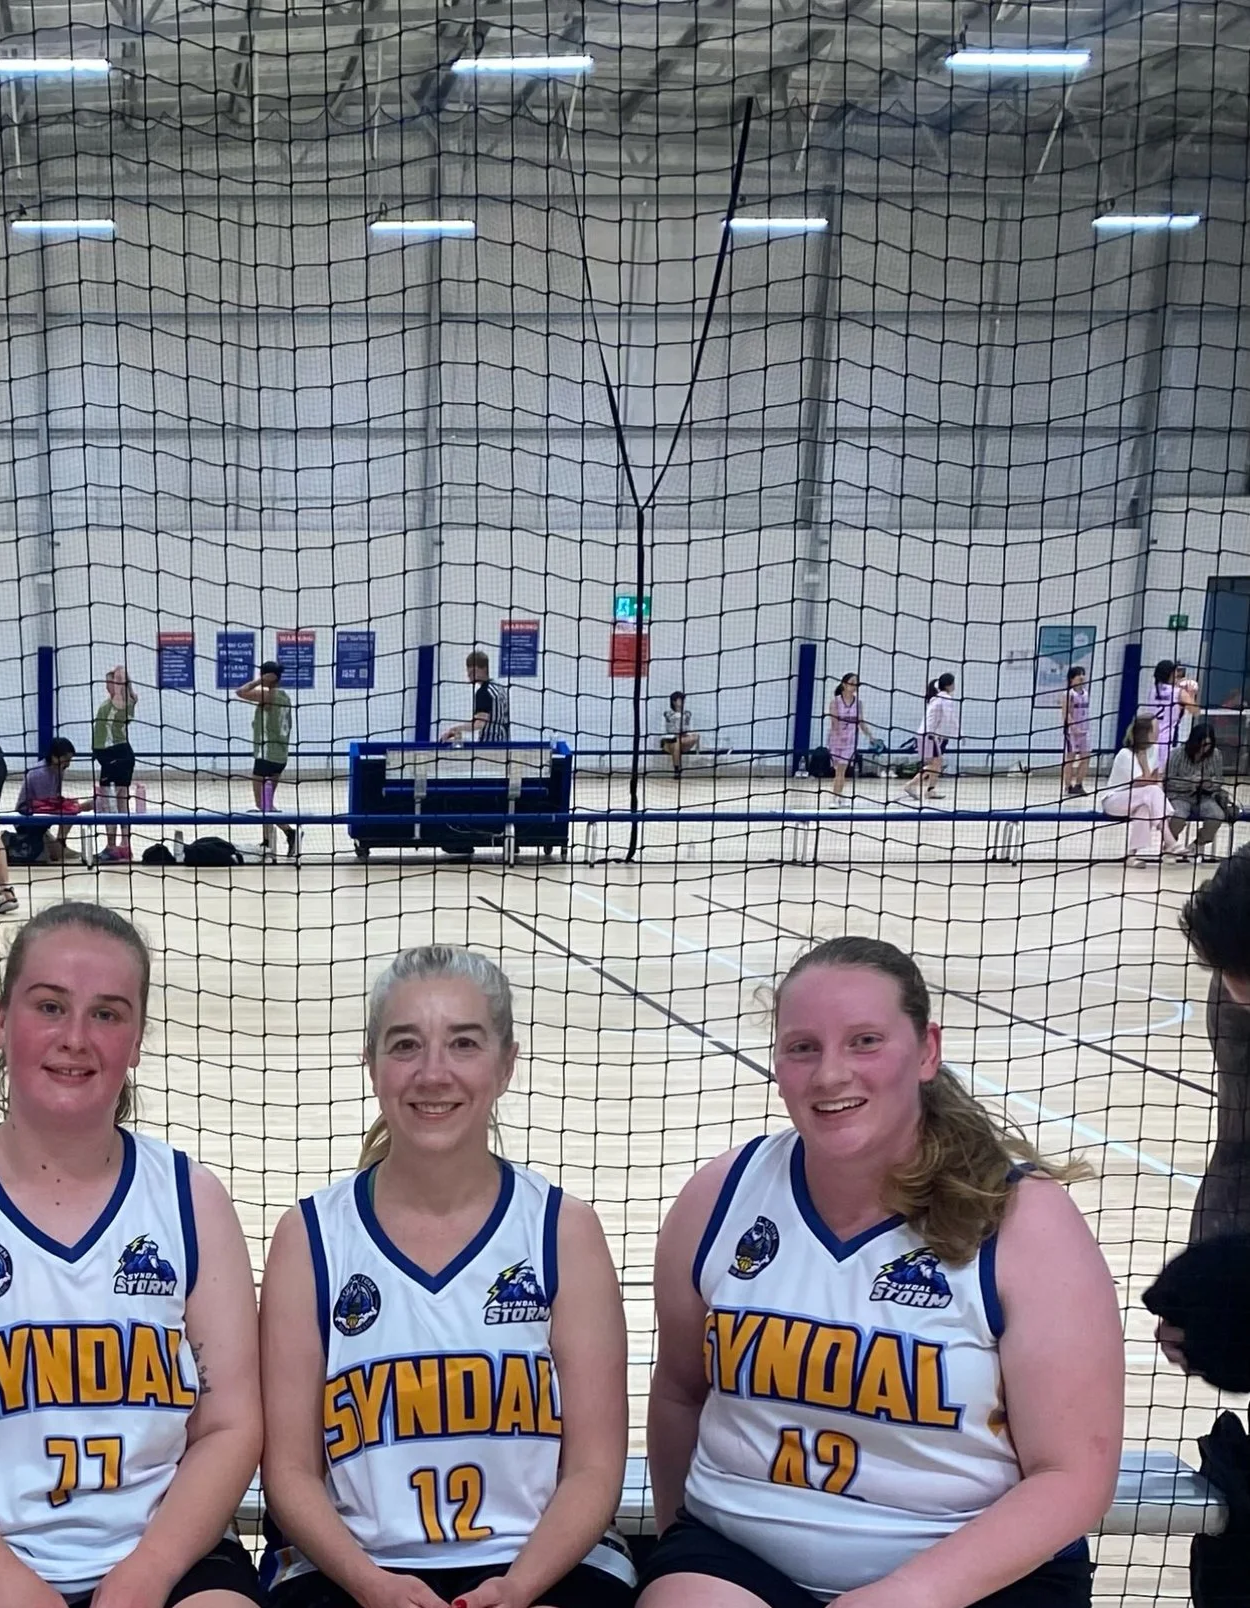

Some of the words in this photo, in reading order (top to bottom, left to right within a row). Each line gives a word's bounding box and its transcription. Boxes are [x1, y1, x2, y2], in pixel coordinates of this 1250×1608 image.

[115, 1276, 177, 1294] STORM
[127, 1272, 159, 1281] SYNDA
[870, 1283, 951, 1308] STORM
[890, 1281, 931, 1293] SYNDAL
[502, 1300, 537, 1308] SYNDAL
[486, 1306, 550, 1324] STORM
[324, 1352, 562, 1464] SYNDAL
[44, 1436, 123, 1508] 77
[410, 1464, 493, 1544] 12
